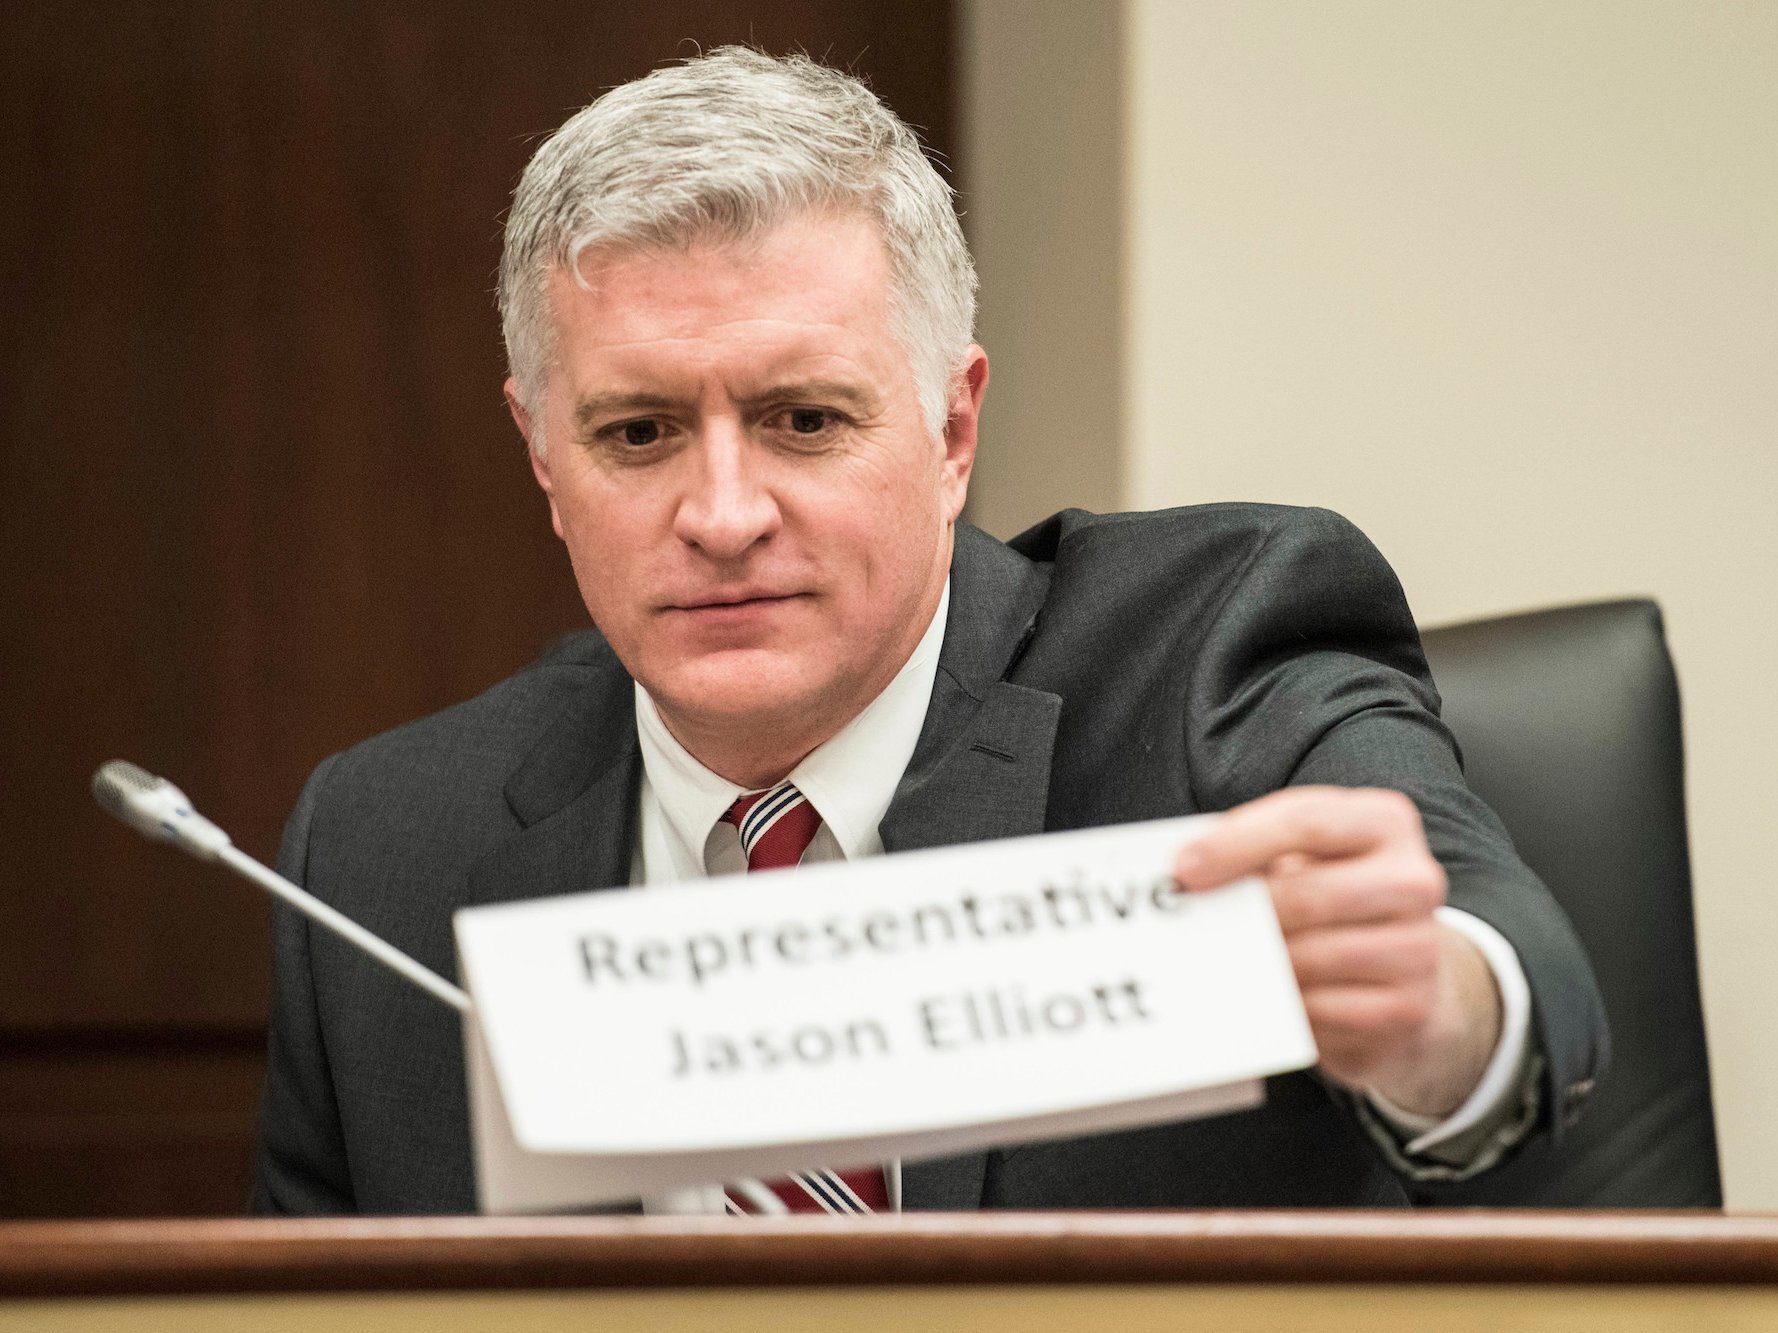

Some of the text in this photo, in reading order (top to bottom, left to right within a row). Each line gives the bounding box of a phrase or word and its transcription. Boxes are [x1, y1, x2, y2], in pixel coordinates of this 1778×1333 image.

[576, 868, 1187, 987] Representative
[669, 978, 1153, 1079] Jason Elliott
